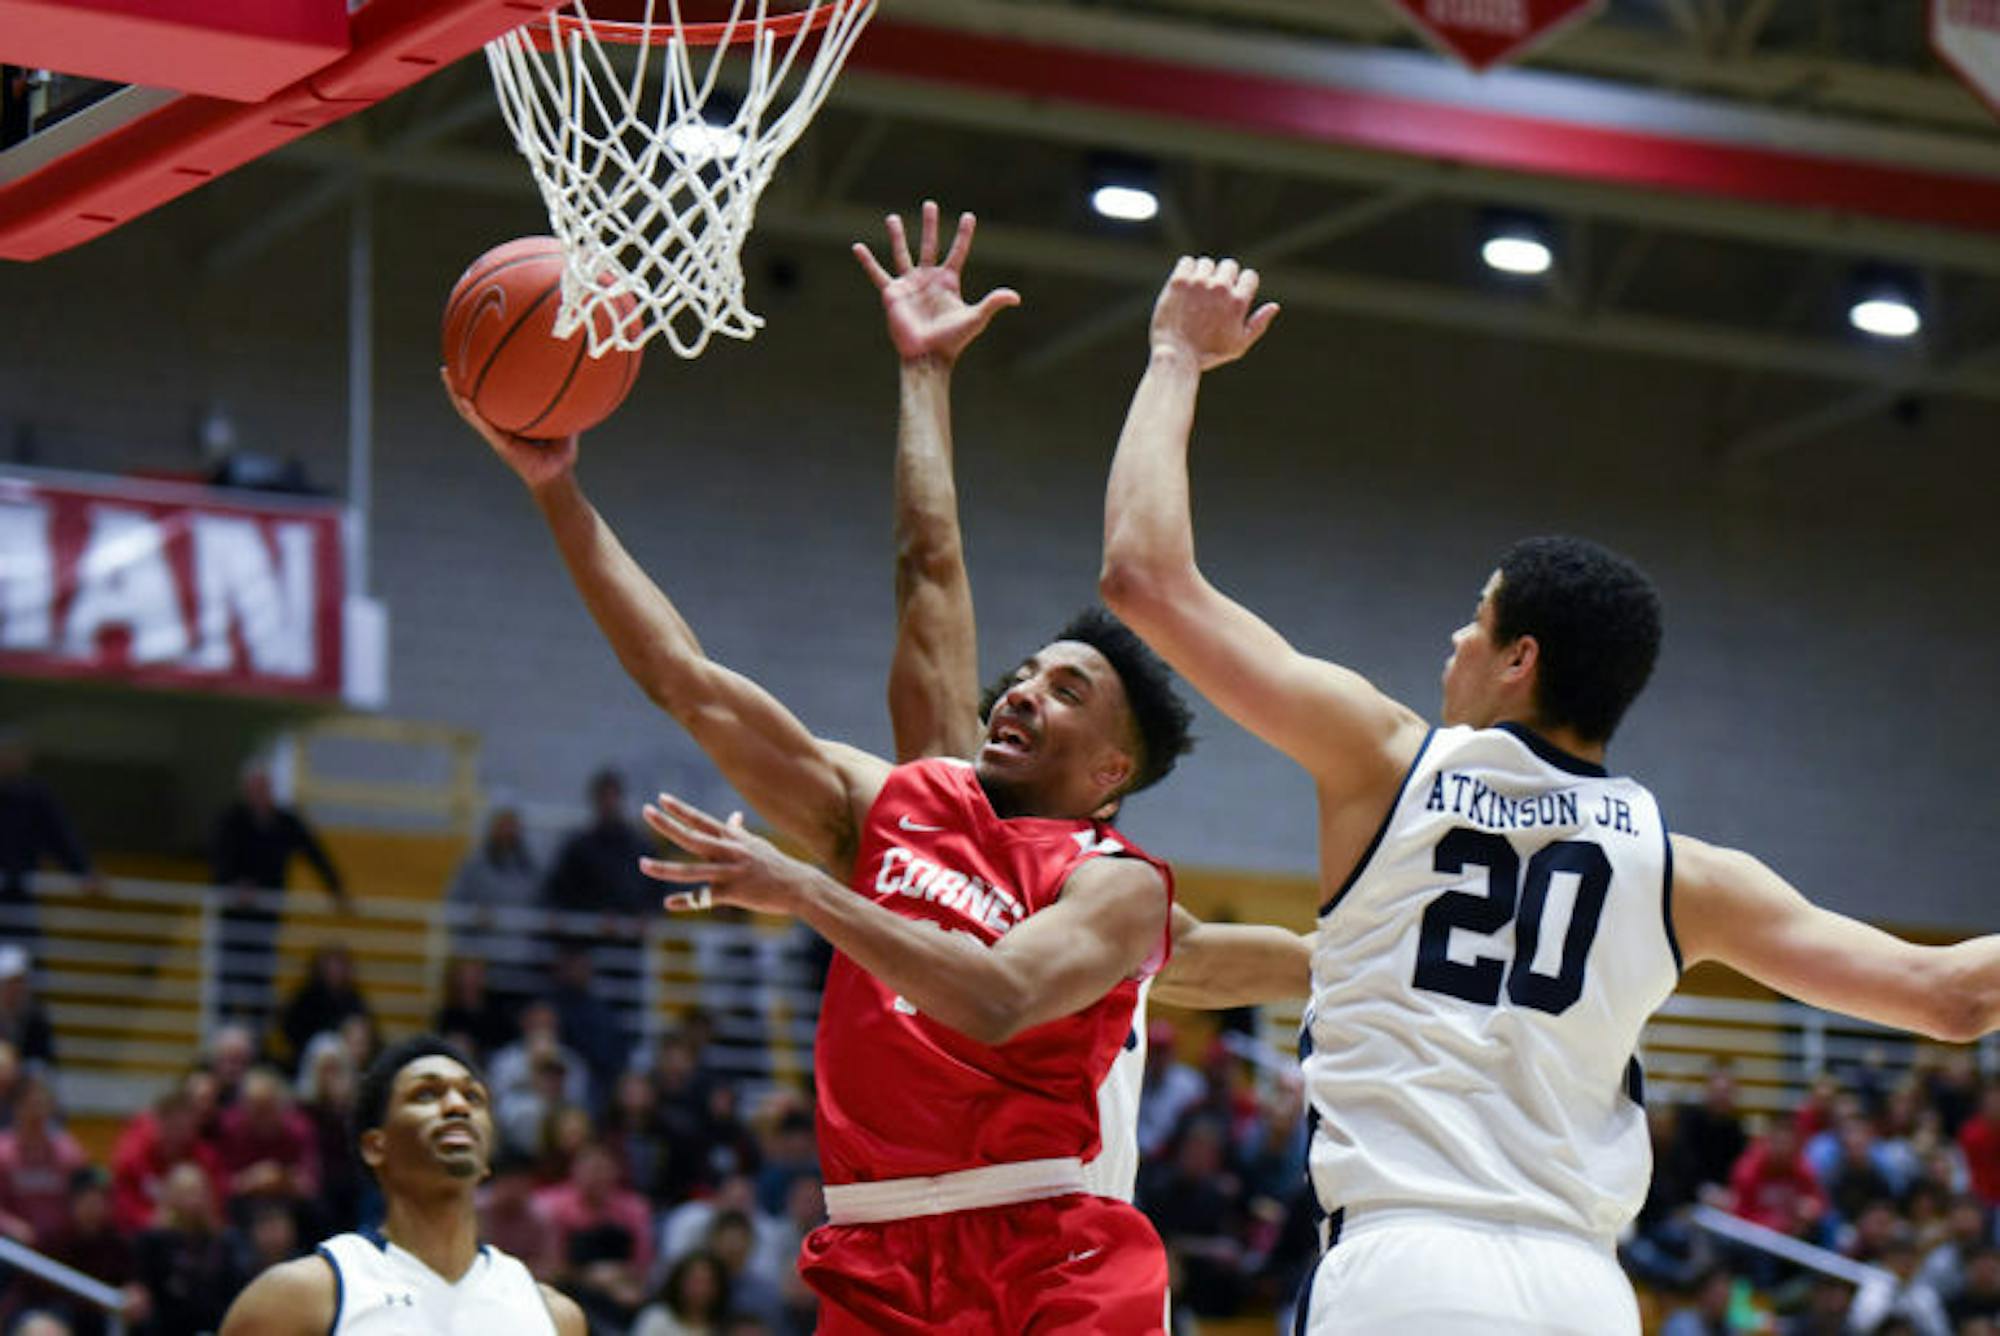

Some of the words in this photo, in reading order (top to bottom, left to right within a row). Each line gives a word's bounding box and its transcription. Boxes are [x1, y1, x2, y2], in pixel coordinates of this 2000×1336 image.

[1426, 770, 1578, 828] ATKINSON
[1595, 795, 1640, 837] JR.
[1412, 827, 1613, 1017] 20
